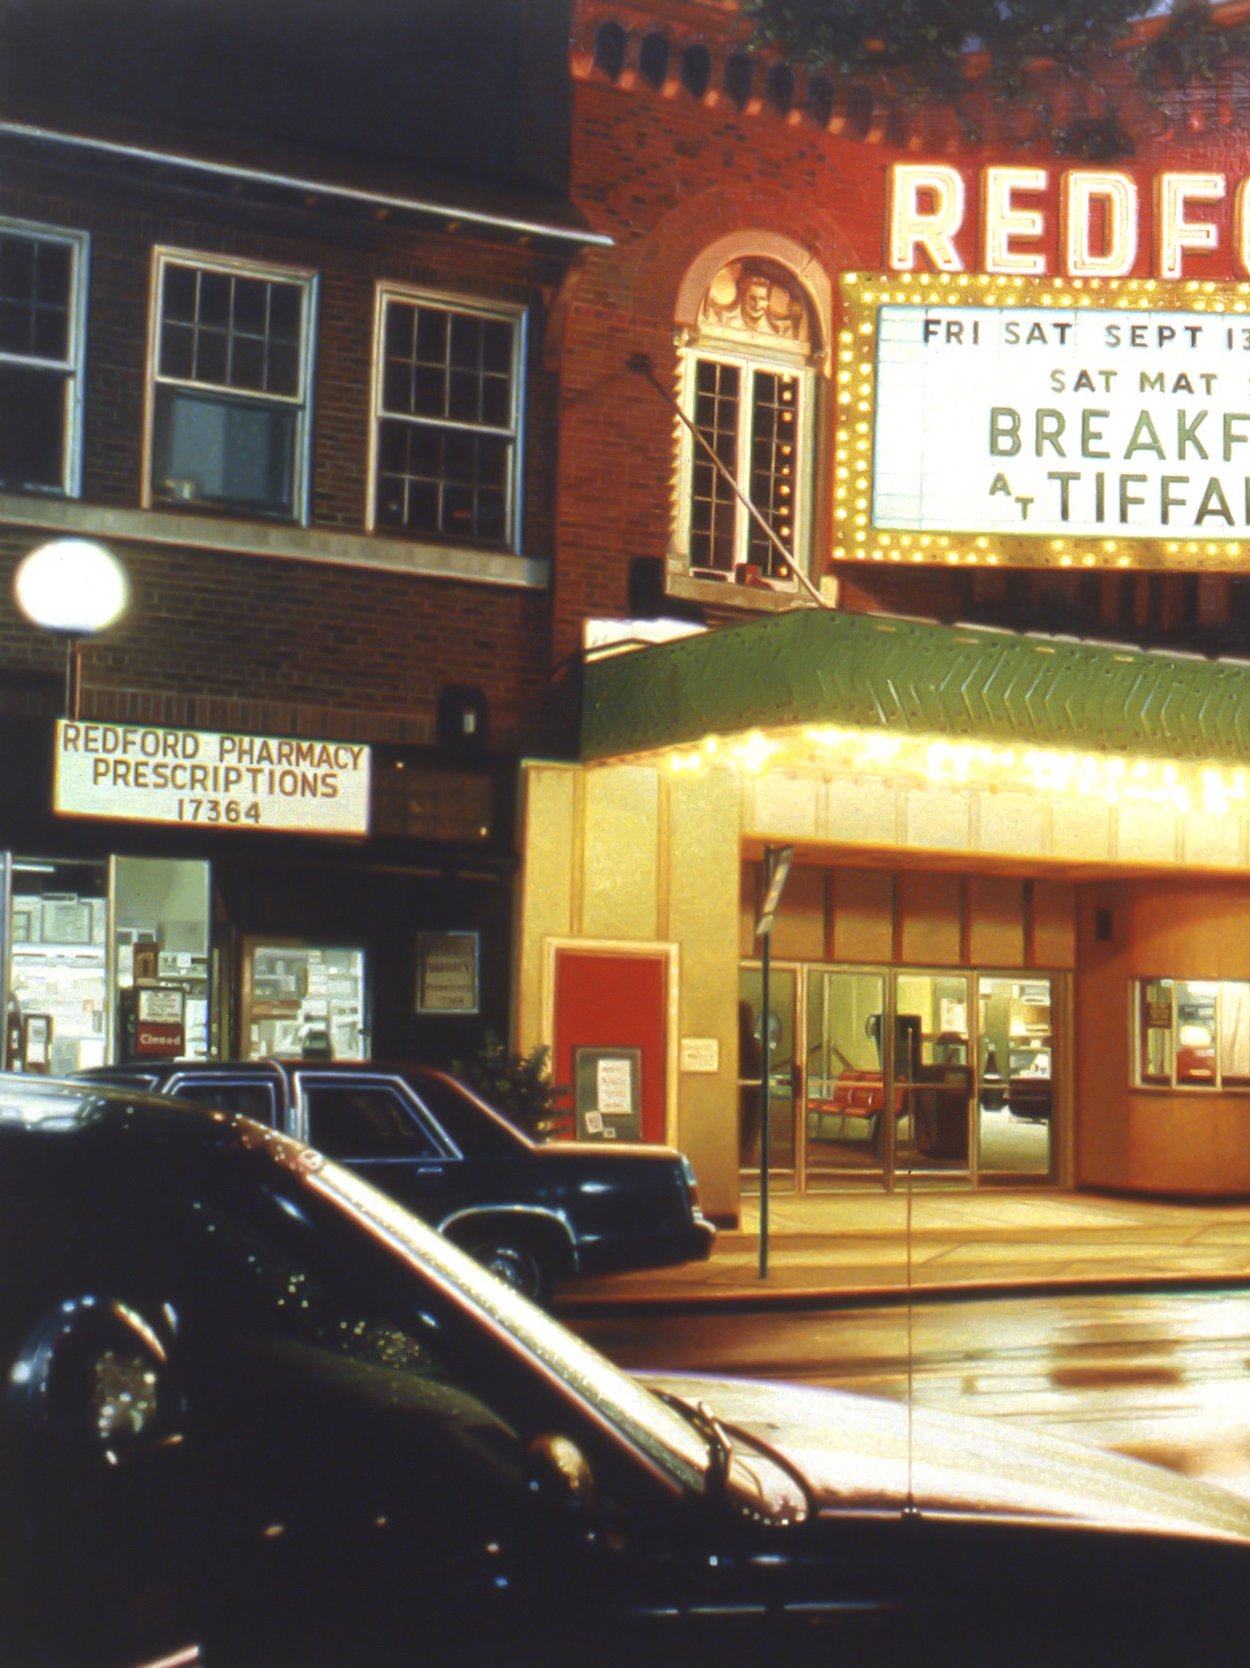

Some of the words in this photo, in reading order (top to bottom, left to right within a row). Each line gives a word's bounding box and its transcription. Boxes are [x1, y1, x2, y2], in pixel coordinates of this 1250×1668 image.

[922, 318, 980, 345] FRI
[1004, 321, 1073, 345] SAT
[1104, 324, 1203, 348] SEPT
[1049, 368, 1118, 393] SAT
[1139, 371, 1218, 396] MAT
[62, 722, 200, 759] REDFORD
[218, 735, 365, 771] PHARMACY
[92, 757, 339, 799] PRESCRIPTIONS
[177, 798, 262, 825] 17364
